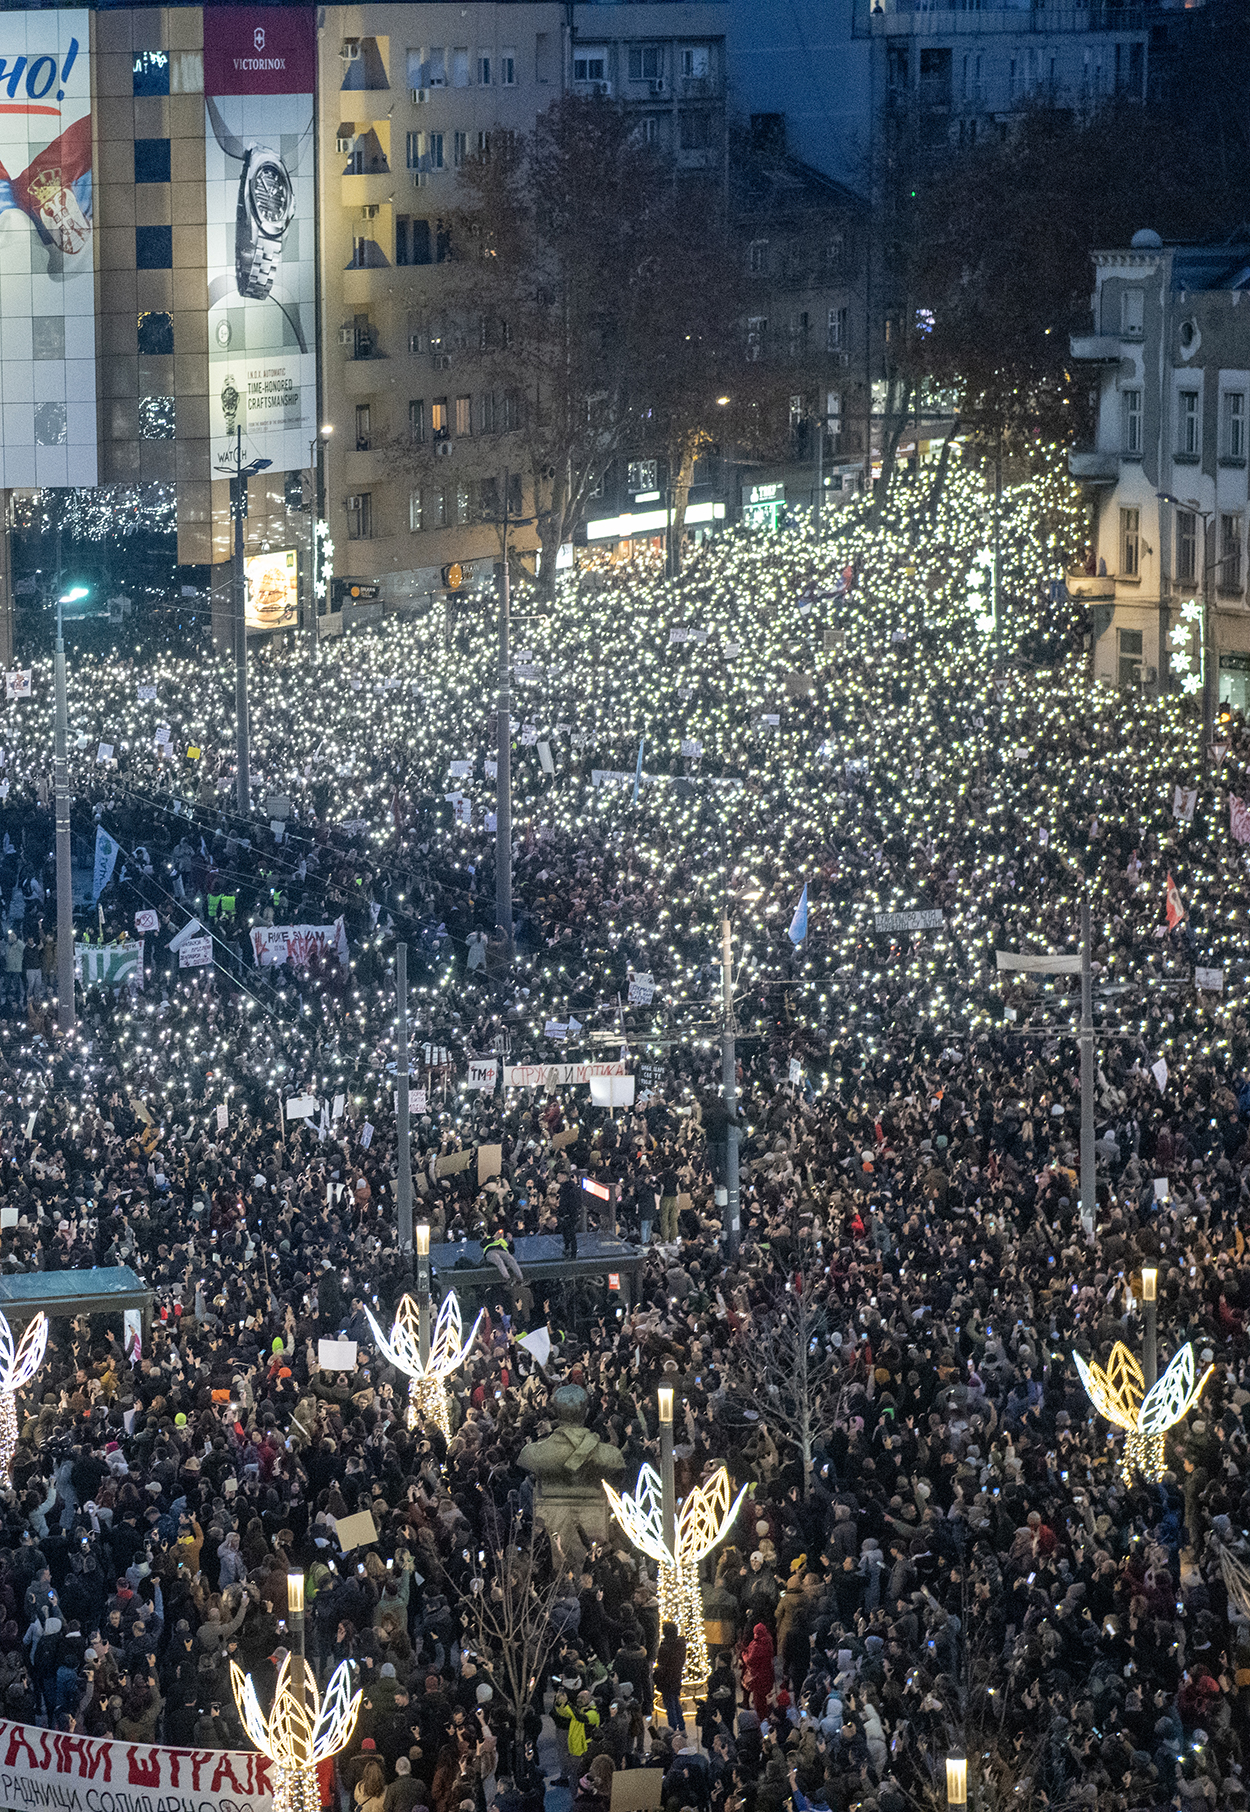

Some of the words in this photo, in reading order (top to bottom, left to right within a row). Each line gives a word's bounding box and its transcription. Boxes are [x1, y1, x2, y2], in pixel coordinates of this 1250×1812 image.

[233, 58, 286, 70] VICTORINOX
[248, 379, 293, 394] TIME-HONORED
[248, 394, 299, 410] CRAFTSMANSHIP
[564, 1067, 573, 1082] И
[1, 1773, 82, 1812] РАДНИЦИ
